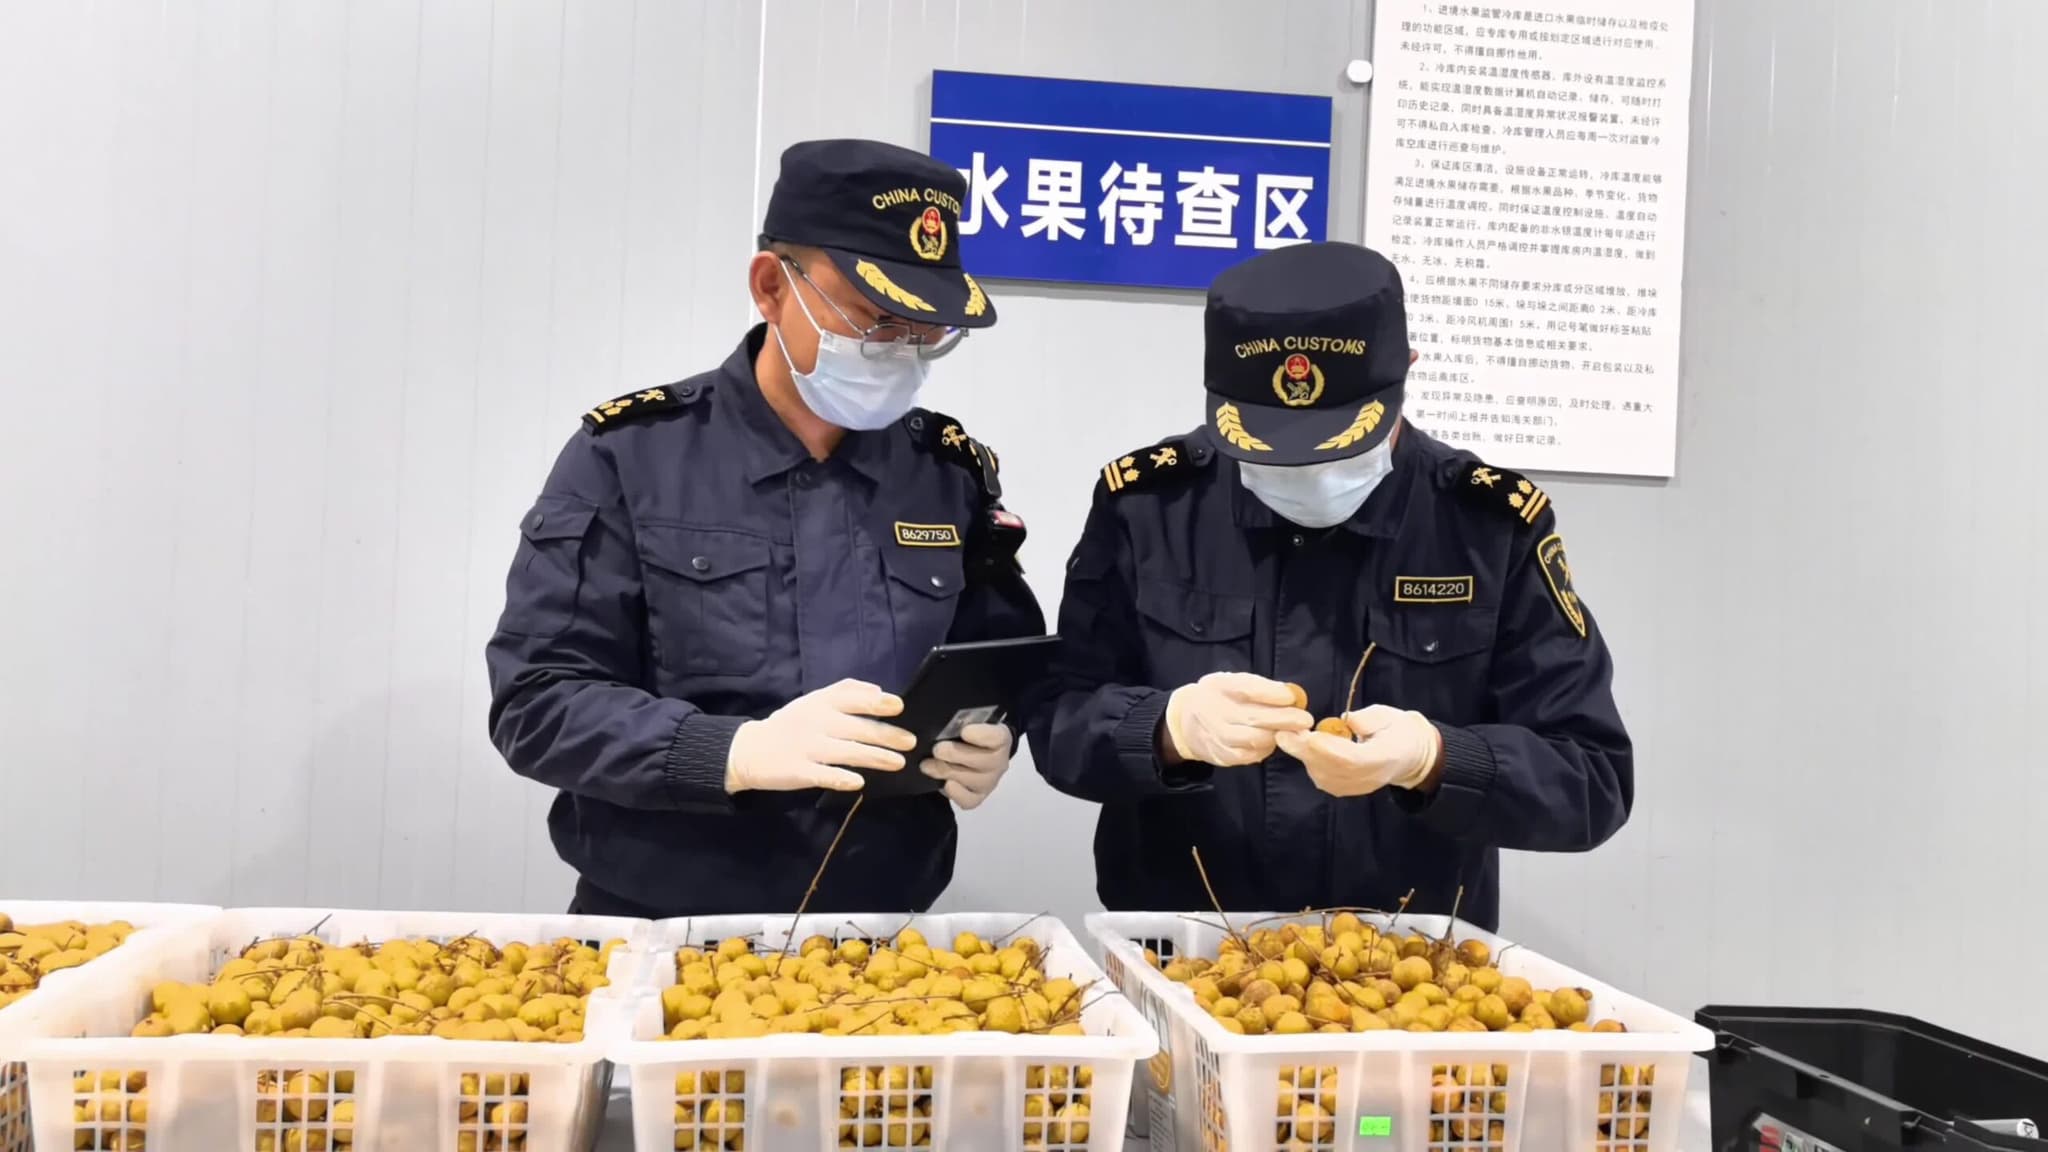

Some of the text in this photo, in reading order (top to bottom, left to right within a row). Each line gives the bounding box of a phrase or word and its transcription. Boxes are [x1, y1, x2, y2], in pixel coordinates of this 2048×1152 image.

[872, 187, 921, 210] CHINA
[957, 152, 1314, 249] 水果待查区
[1235, 335, 1366, 358] CHINA CUSTOMS
[901, 528, 951, 541] 8629750
[1403, 582, 1464, 596] 8614220
